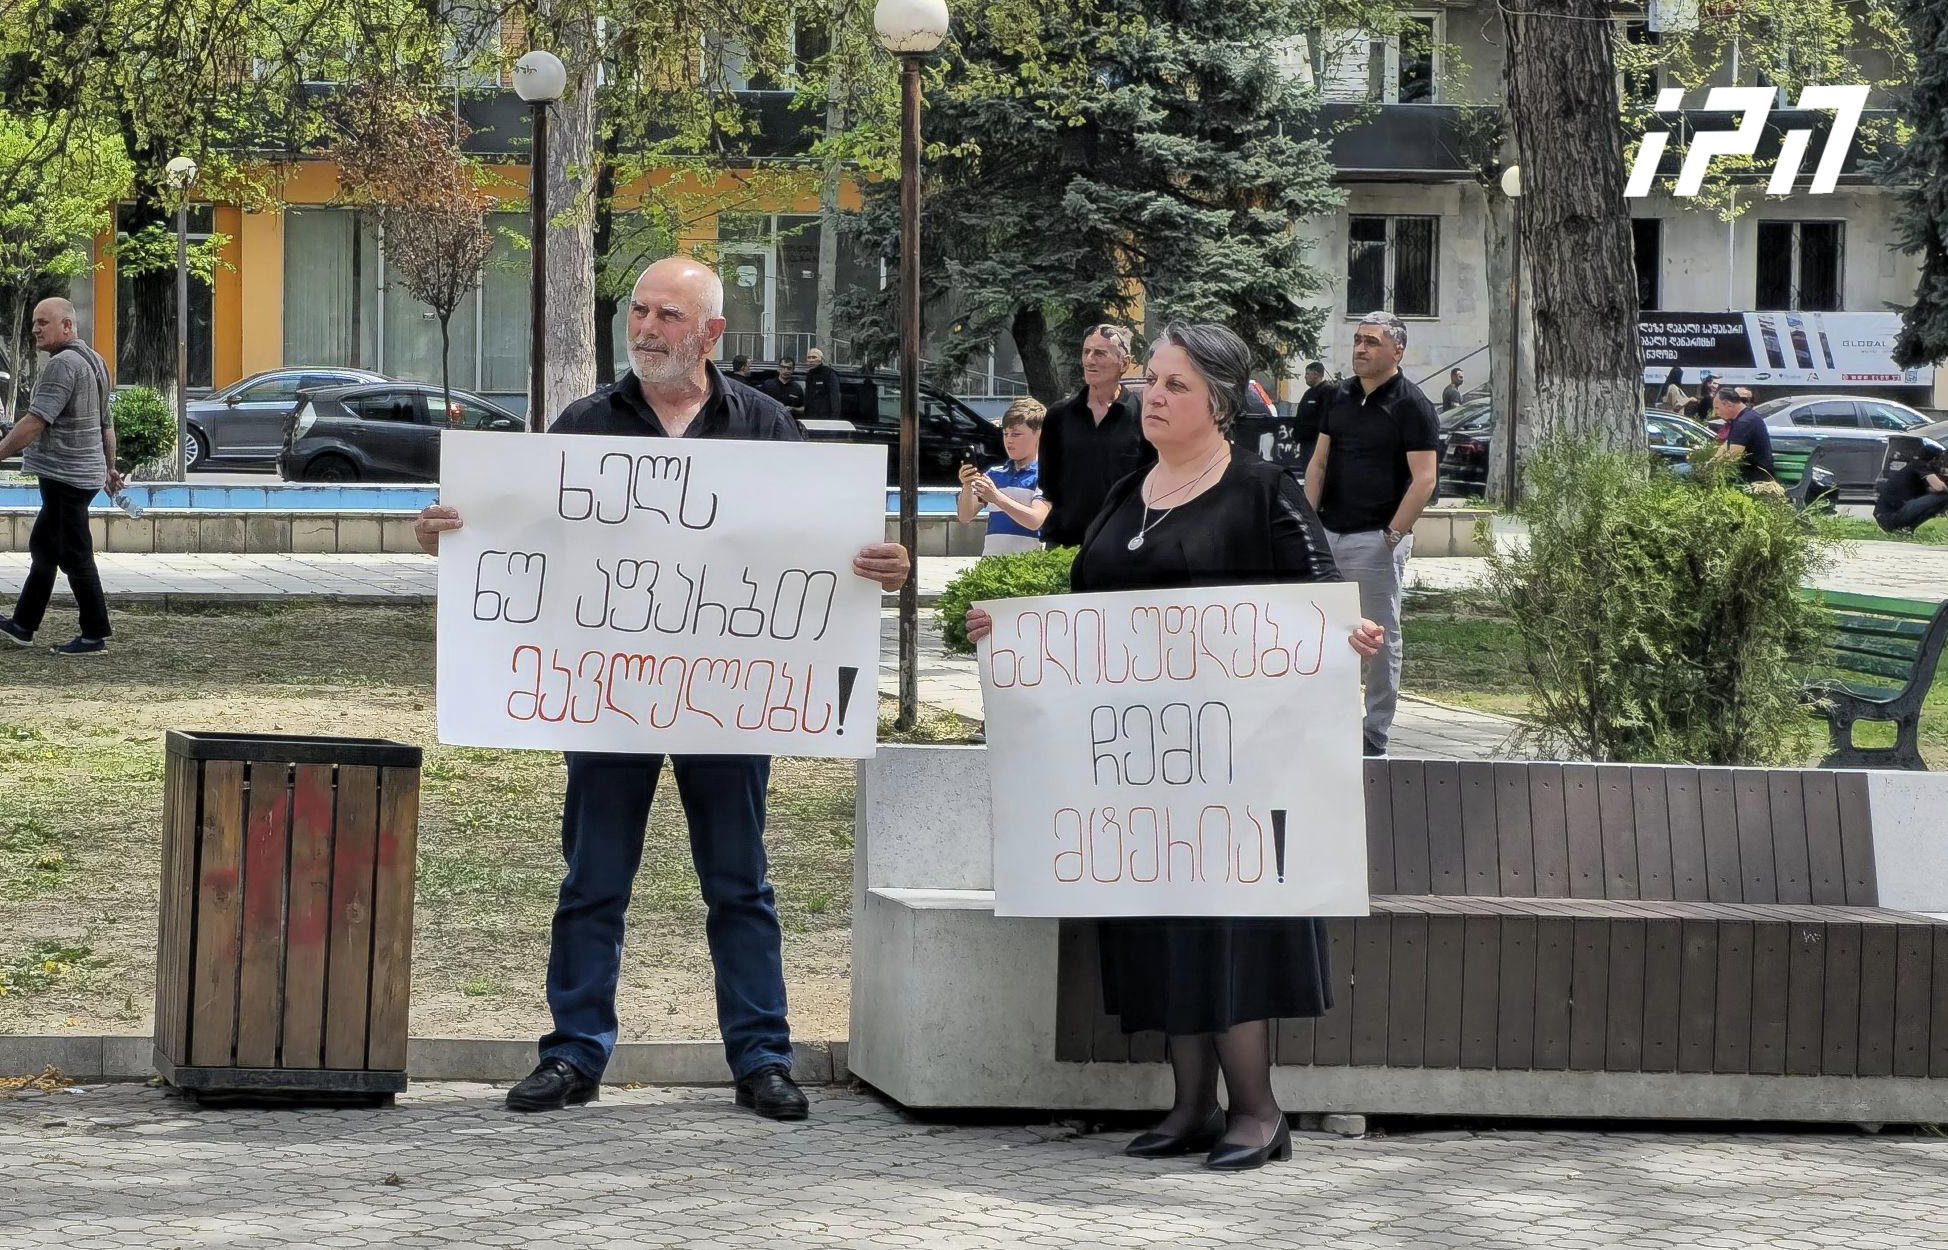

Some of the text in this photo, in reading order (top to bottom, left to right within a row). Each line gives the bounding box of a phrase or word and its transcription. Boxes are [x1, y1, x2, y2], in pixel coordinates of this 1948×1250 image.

[1640, 323, 1665, 334] ლაზე
[1640, 337, 1668, 347] აბალი
[559, 450, 718, 530] ხელს
[474, 550, 547, 624] ნუ
[990, 601, 1326, 688] ხელისუფლება
[1090, 701, 1233, 786] ჩემი
[1054, 805, 1288, 884] მტერია!
